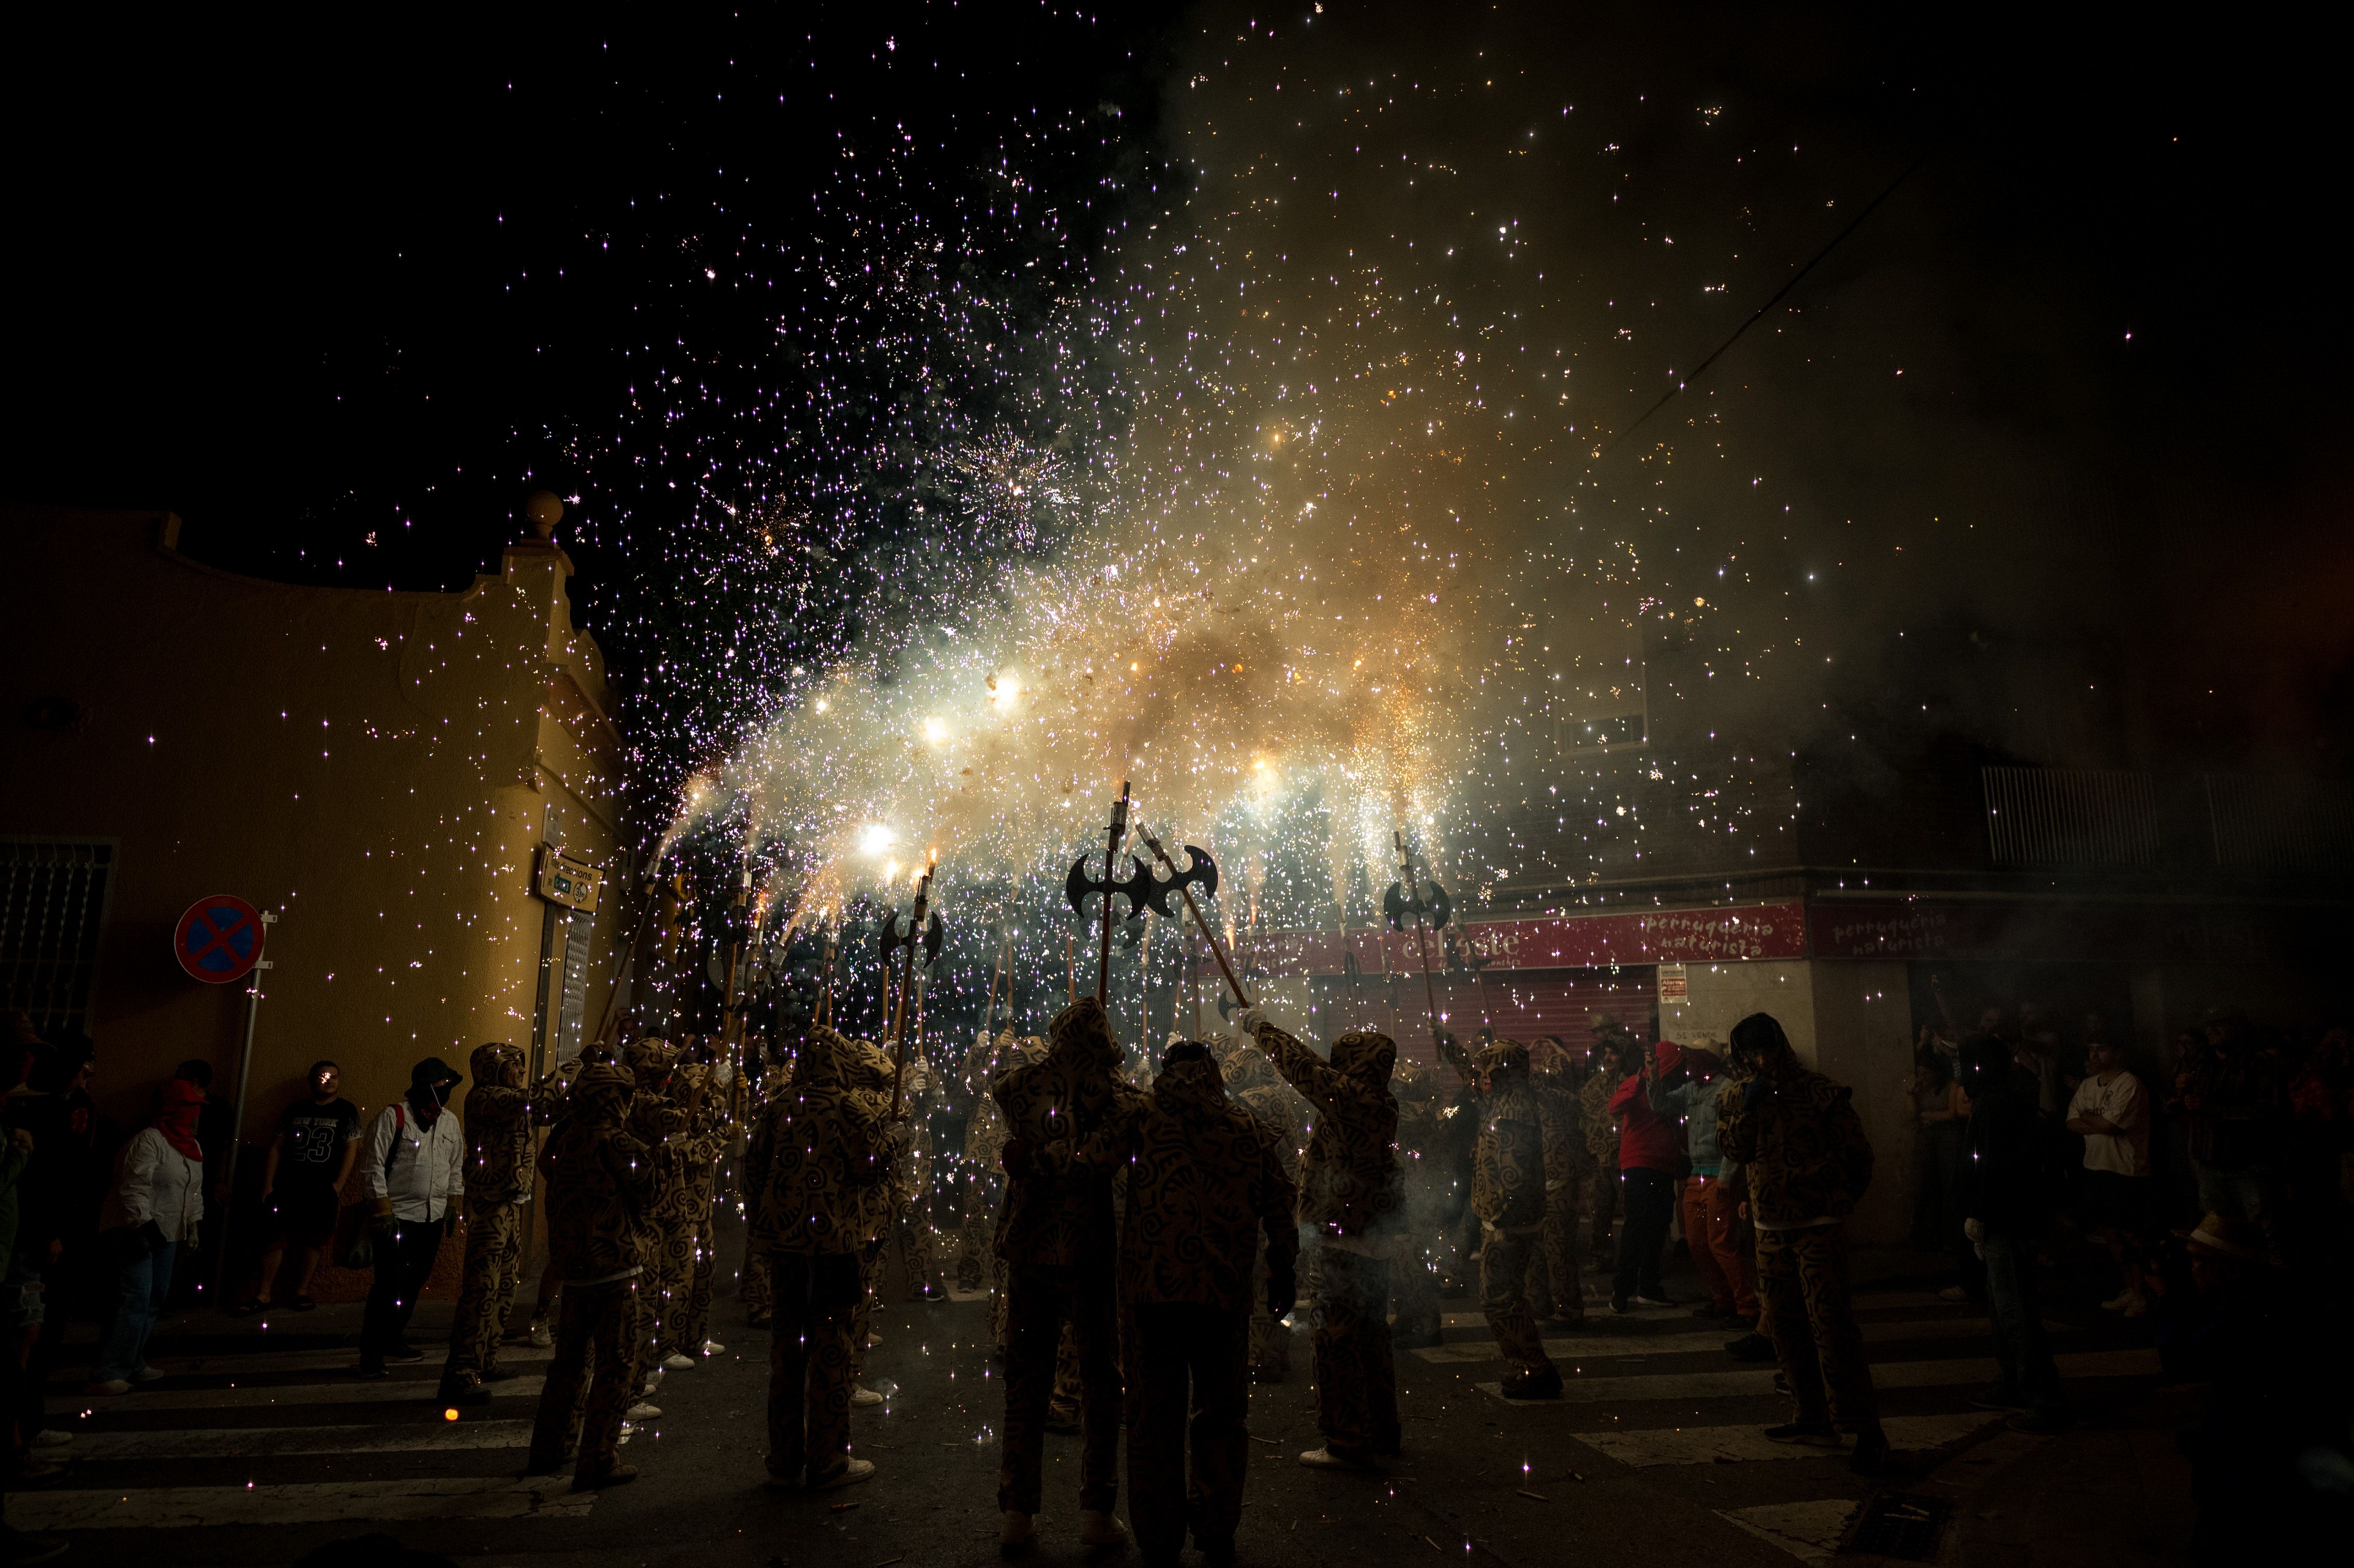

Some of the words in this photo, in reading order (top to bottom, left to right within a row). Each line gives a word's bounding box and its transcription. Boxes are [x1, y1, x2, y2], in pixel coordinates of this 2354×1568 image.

[560, 861, 592, 881] direccions
[1644, 917, 1773, 938] perruqueria
[1661, 934, 1762, 957] naturista
[313, 1117, 339, 1128] YORK
[288, 1126, 334, 1162] 23
